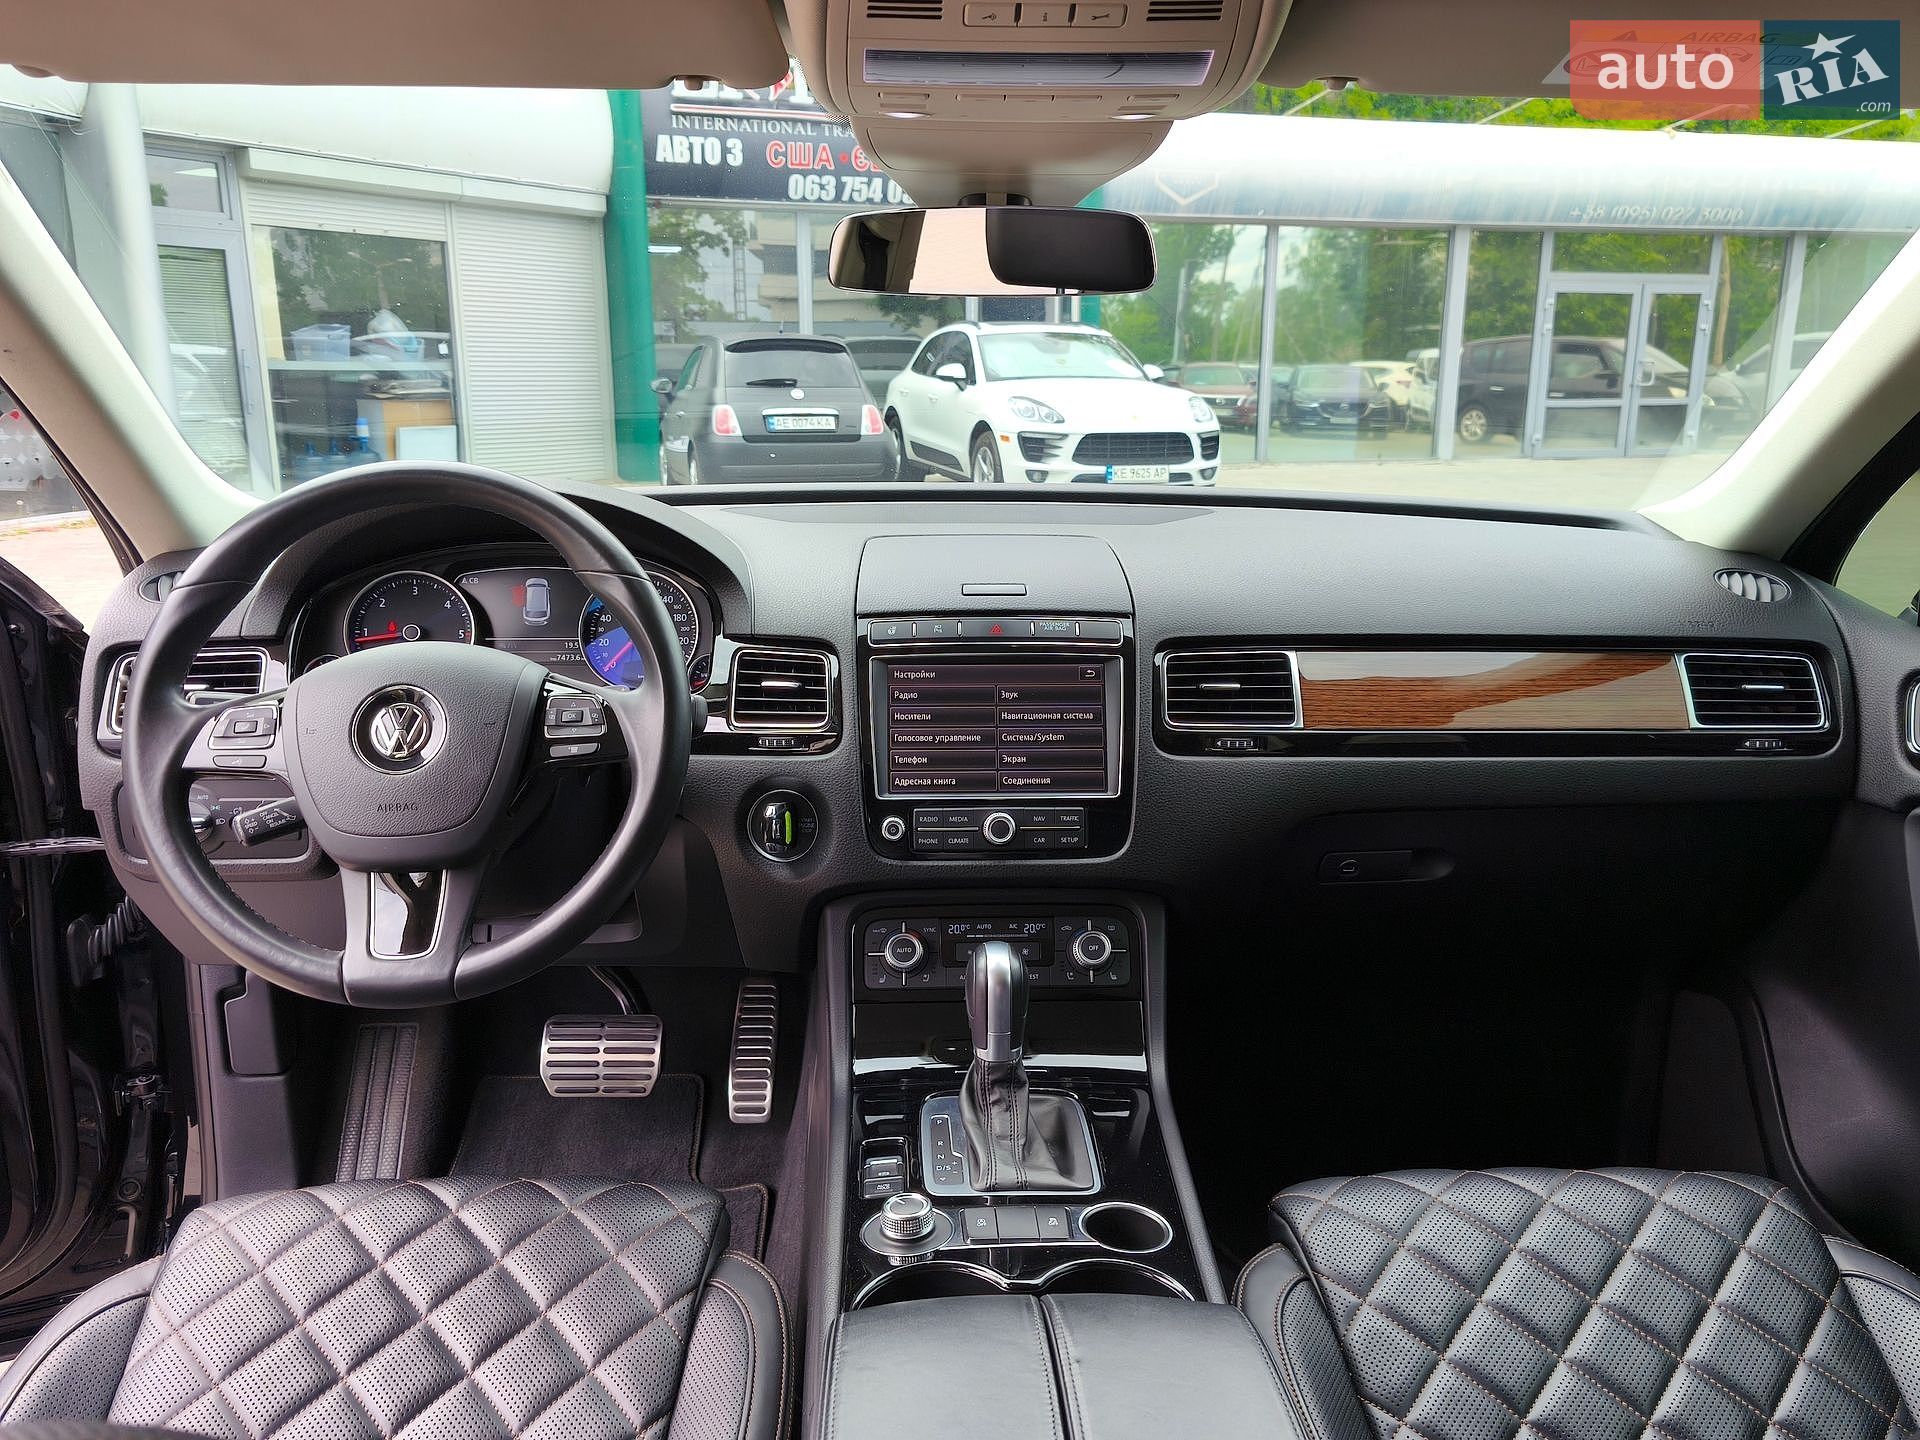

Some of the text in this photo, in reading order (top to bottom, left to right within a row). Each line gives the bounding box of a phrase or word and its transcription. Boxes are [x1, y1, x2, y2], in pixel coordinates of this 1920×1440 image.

[671, 114, 817, 136] INTERNATIONAL
[655, 134, 722, 166] АВТО
[766, 140, 835, 170] США
[787, 174, 837, 201] 063
[841, 177, 883, 203] 754
[600, 615, 612, 623] 40
[673, 614, 687, 622] 180
[599, 639, 609, 647] 20
[894, 670, 936, 680] Настройки
[894, 691, 918, 700] Радио
[1001, 691, 1018, 699] Звук
[894, 712, 931, 720] Носители
[1001, 711, 1060, 720] Навигационная
[894, 734, 981, 743] Голосовое управление
[1001, 733, 1065, 742] Система/System
[894, 755, 928, 765] Телефон
[1002, 754, 1026, 764] Экран
[894, 778, 931, 787] Адресная
[1002, 776, 1051, 786] Соединения
